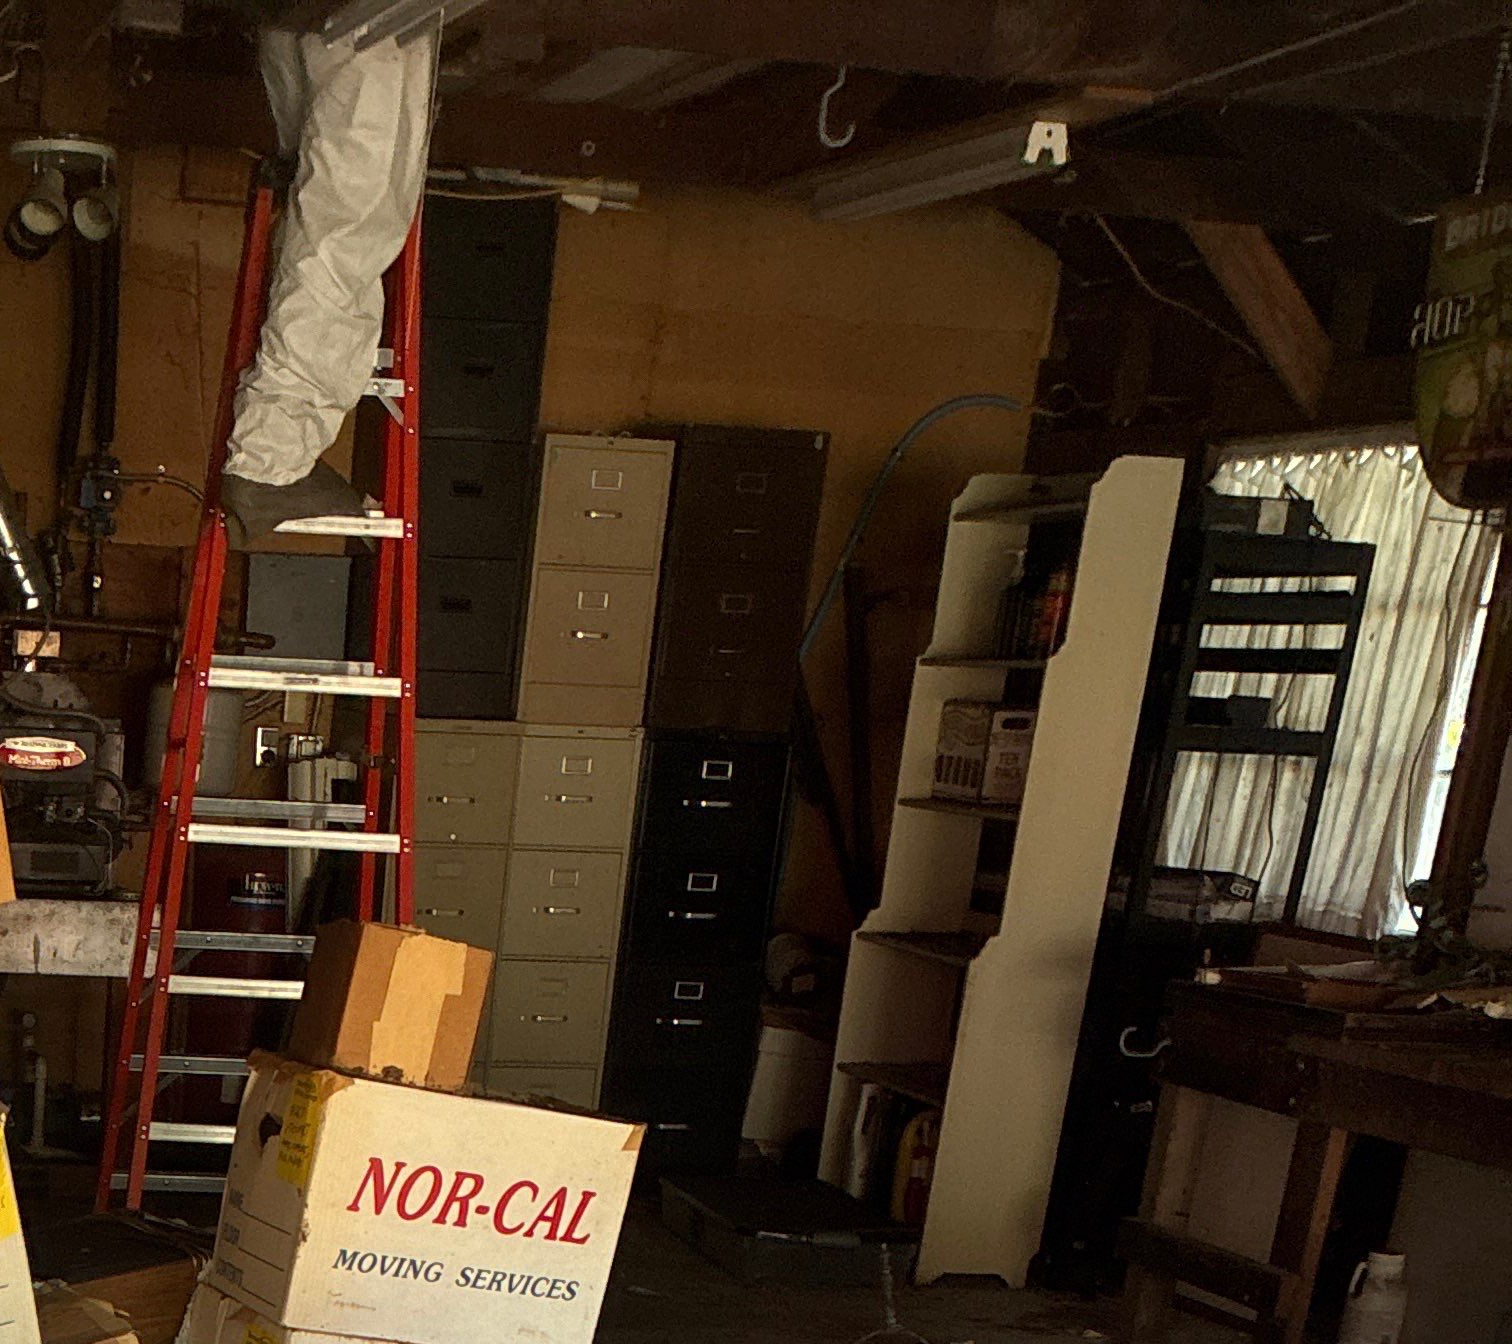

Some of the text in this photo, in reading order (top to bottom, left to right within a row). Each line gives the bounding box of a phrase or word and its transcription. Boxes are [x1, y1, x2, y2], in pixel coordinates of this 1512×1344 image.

[347, 1156, 597, 1245] NOR-CAL
[333, 1248, 580, 1302] MOVING SERVICES
